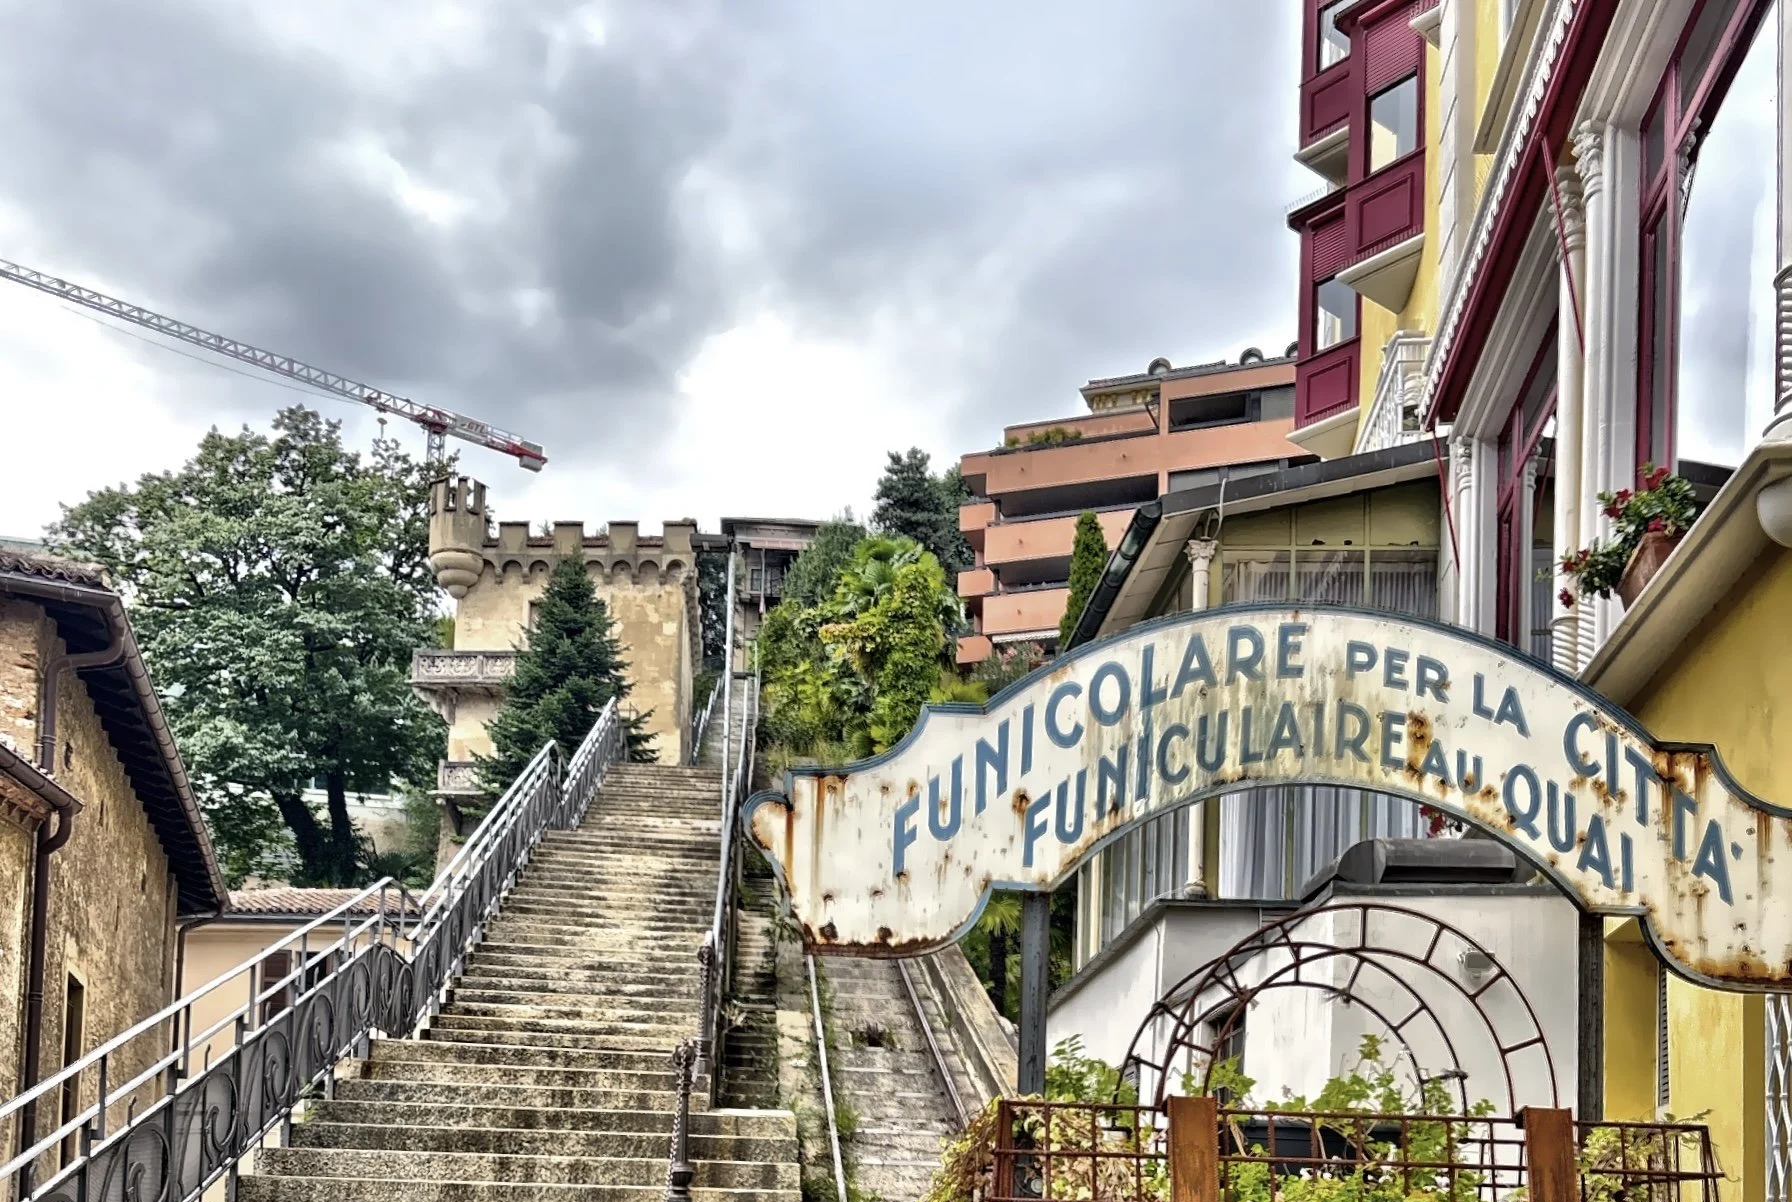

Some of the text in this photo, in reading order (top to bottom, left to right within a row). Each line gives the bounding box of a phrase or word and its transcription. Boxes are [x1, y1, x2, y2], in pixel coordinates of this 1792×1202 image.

[892, 622, 1308, 877] FUNICOLARE
[1346, 640, 1450, 704] PER
[1472, 672, 1531, 739] LA
[1023, 698, 1633, 893] FUNICULAIRE AU QUAI
